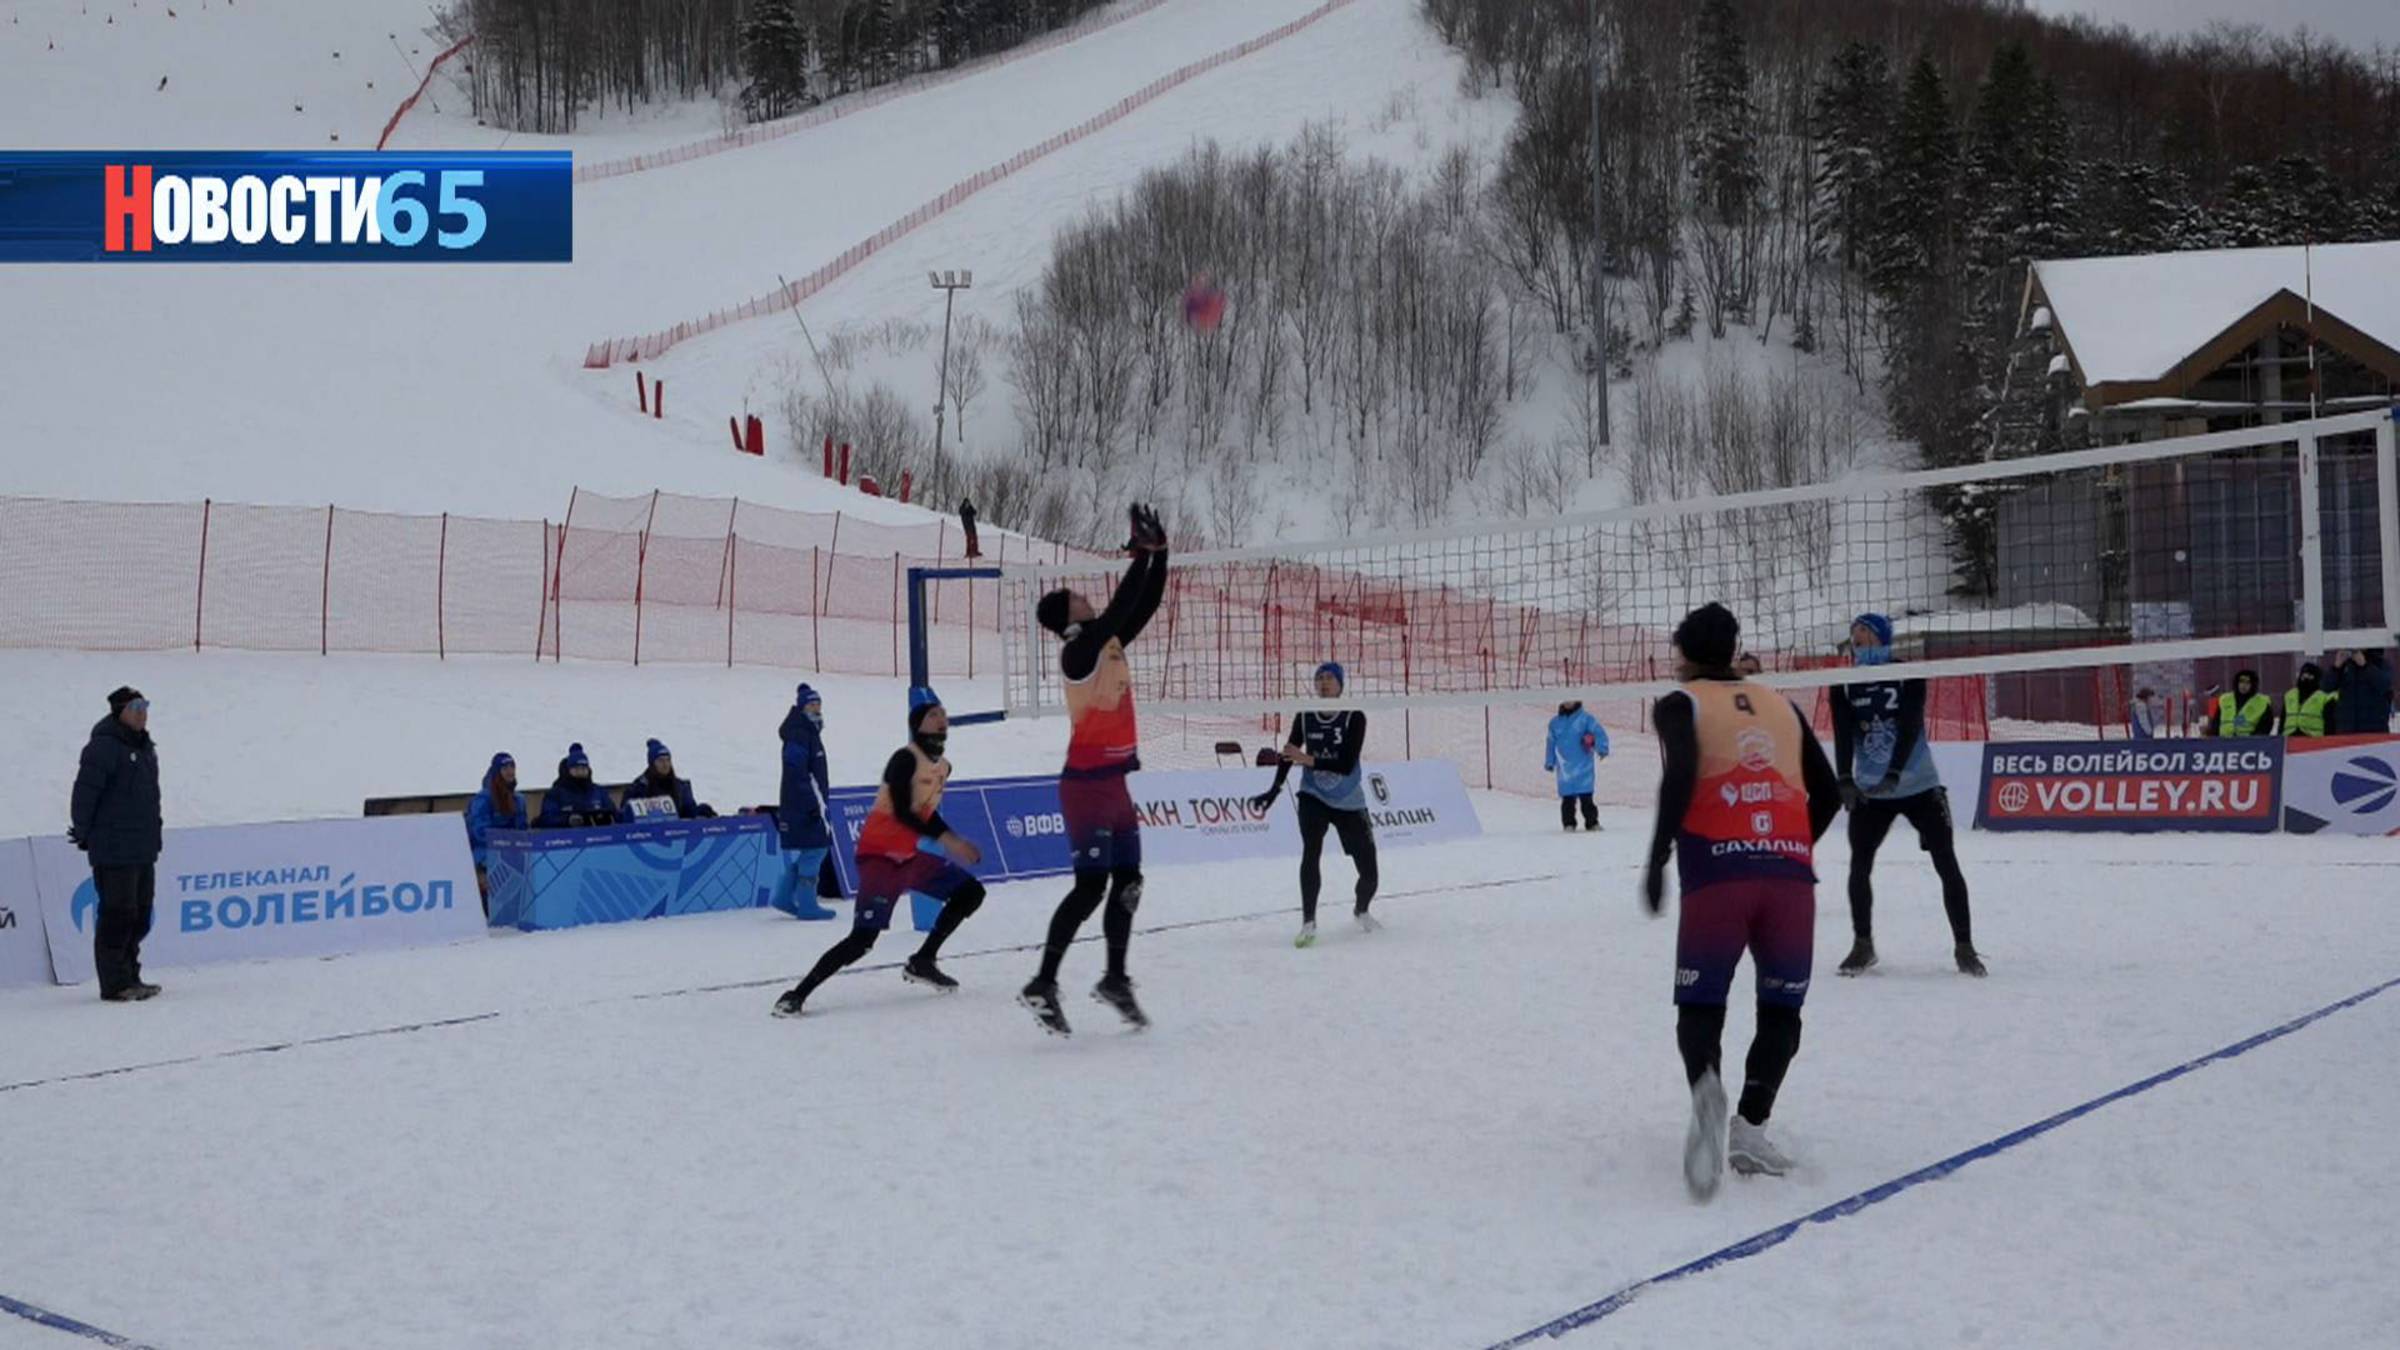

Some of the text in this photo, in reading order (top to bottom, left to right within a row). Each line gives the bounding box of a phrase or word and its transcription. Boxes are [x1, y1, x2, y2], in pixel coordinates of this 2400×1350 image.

[1884, 688, 1899, 709] 2
[1333, 727, 1343, 745] 3
[1992, 750, 2273, 774] ВЕСЬ ВОЛЕЙБОЛ ЗДЕСЬ
[2035, 779, 2258, 812] VOLLEY.RU
[1024, 812, 1066, 837] ВФВ
[1133, 797, 1266, 829] AKH_TOKYO
[1371, 807, 1436, 827] ХАЛИН
[1711, 838, 1809, 857] САХАЛИН
[177, 865, 330, 892] ТЕЛЕКАНАЛ
[180, 872, 453, 934] ВОЛЕЙБОЛ
